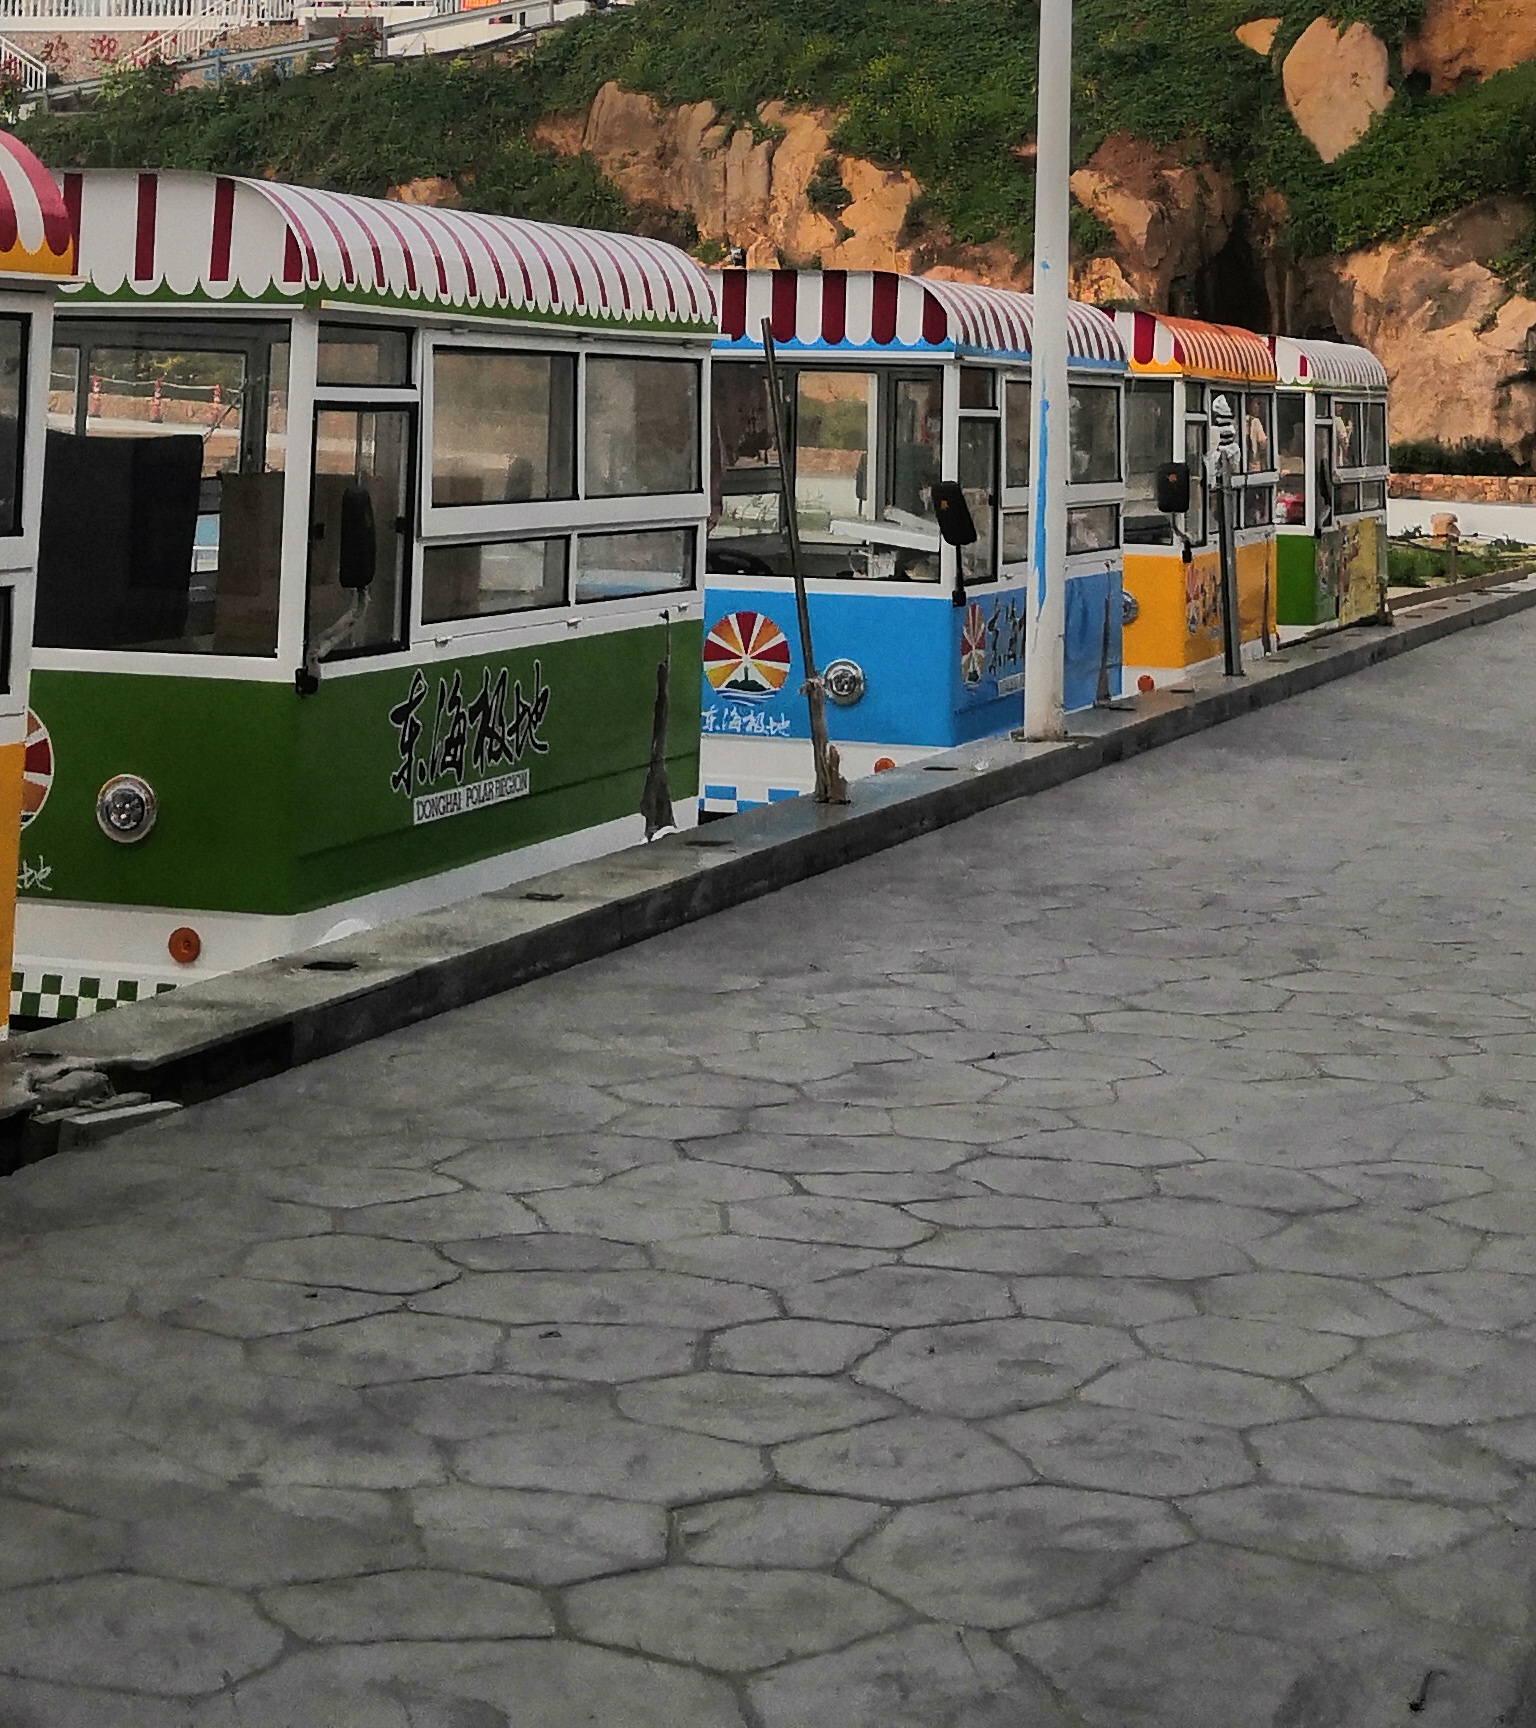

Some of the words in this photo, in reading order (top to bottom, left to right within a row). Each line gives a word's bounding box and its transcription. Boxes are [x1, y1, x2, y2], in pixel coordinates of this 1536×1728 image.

[388, 659, 551, 798] 东海极地
[415, 791, 463, 821] DONGHAI
[465, 781, 495, 808] POLAR
